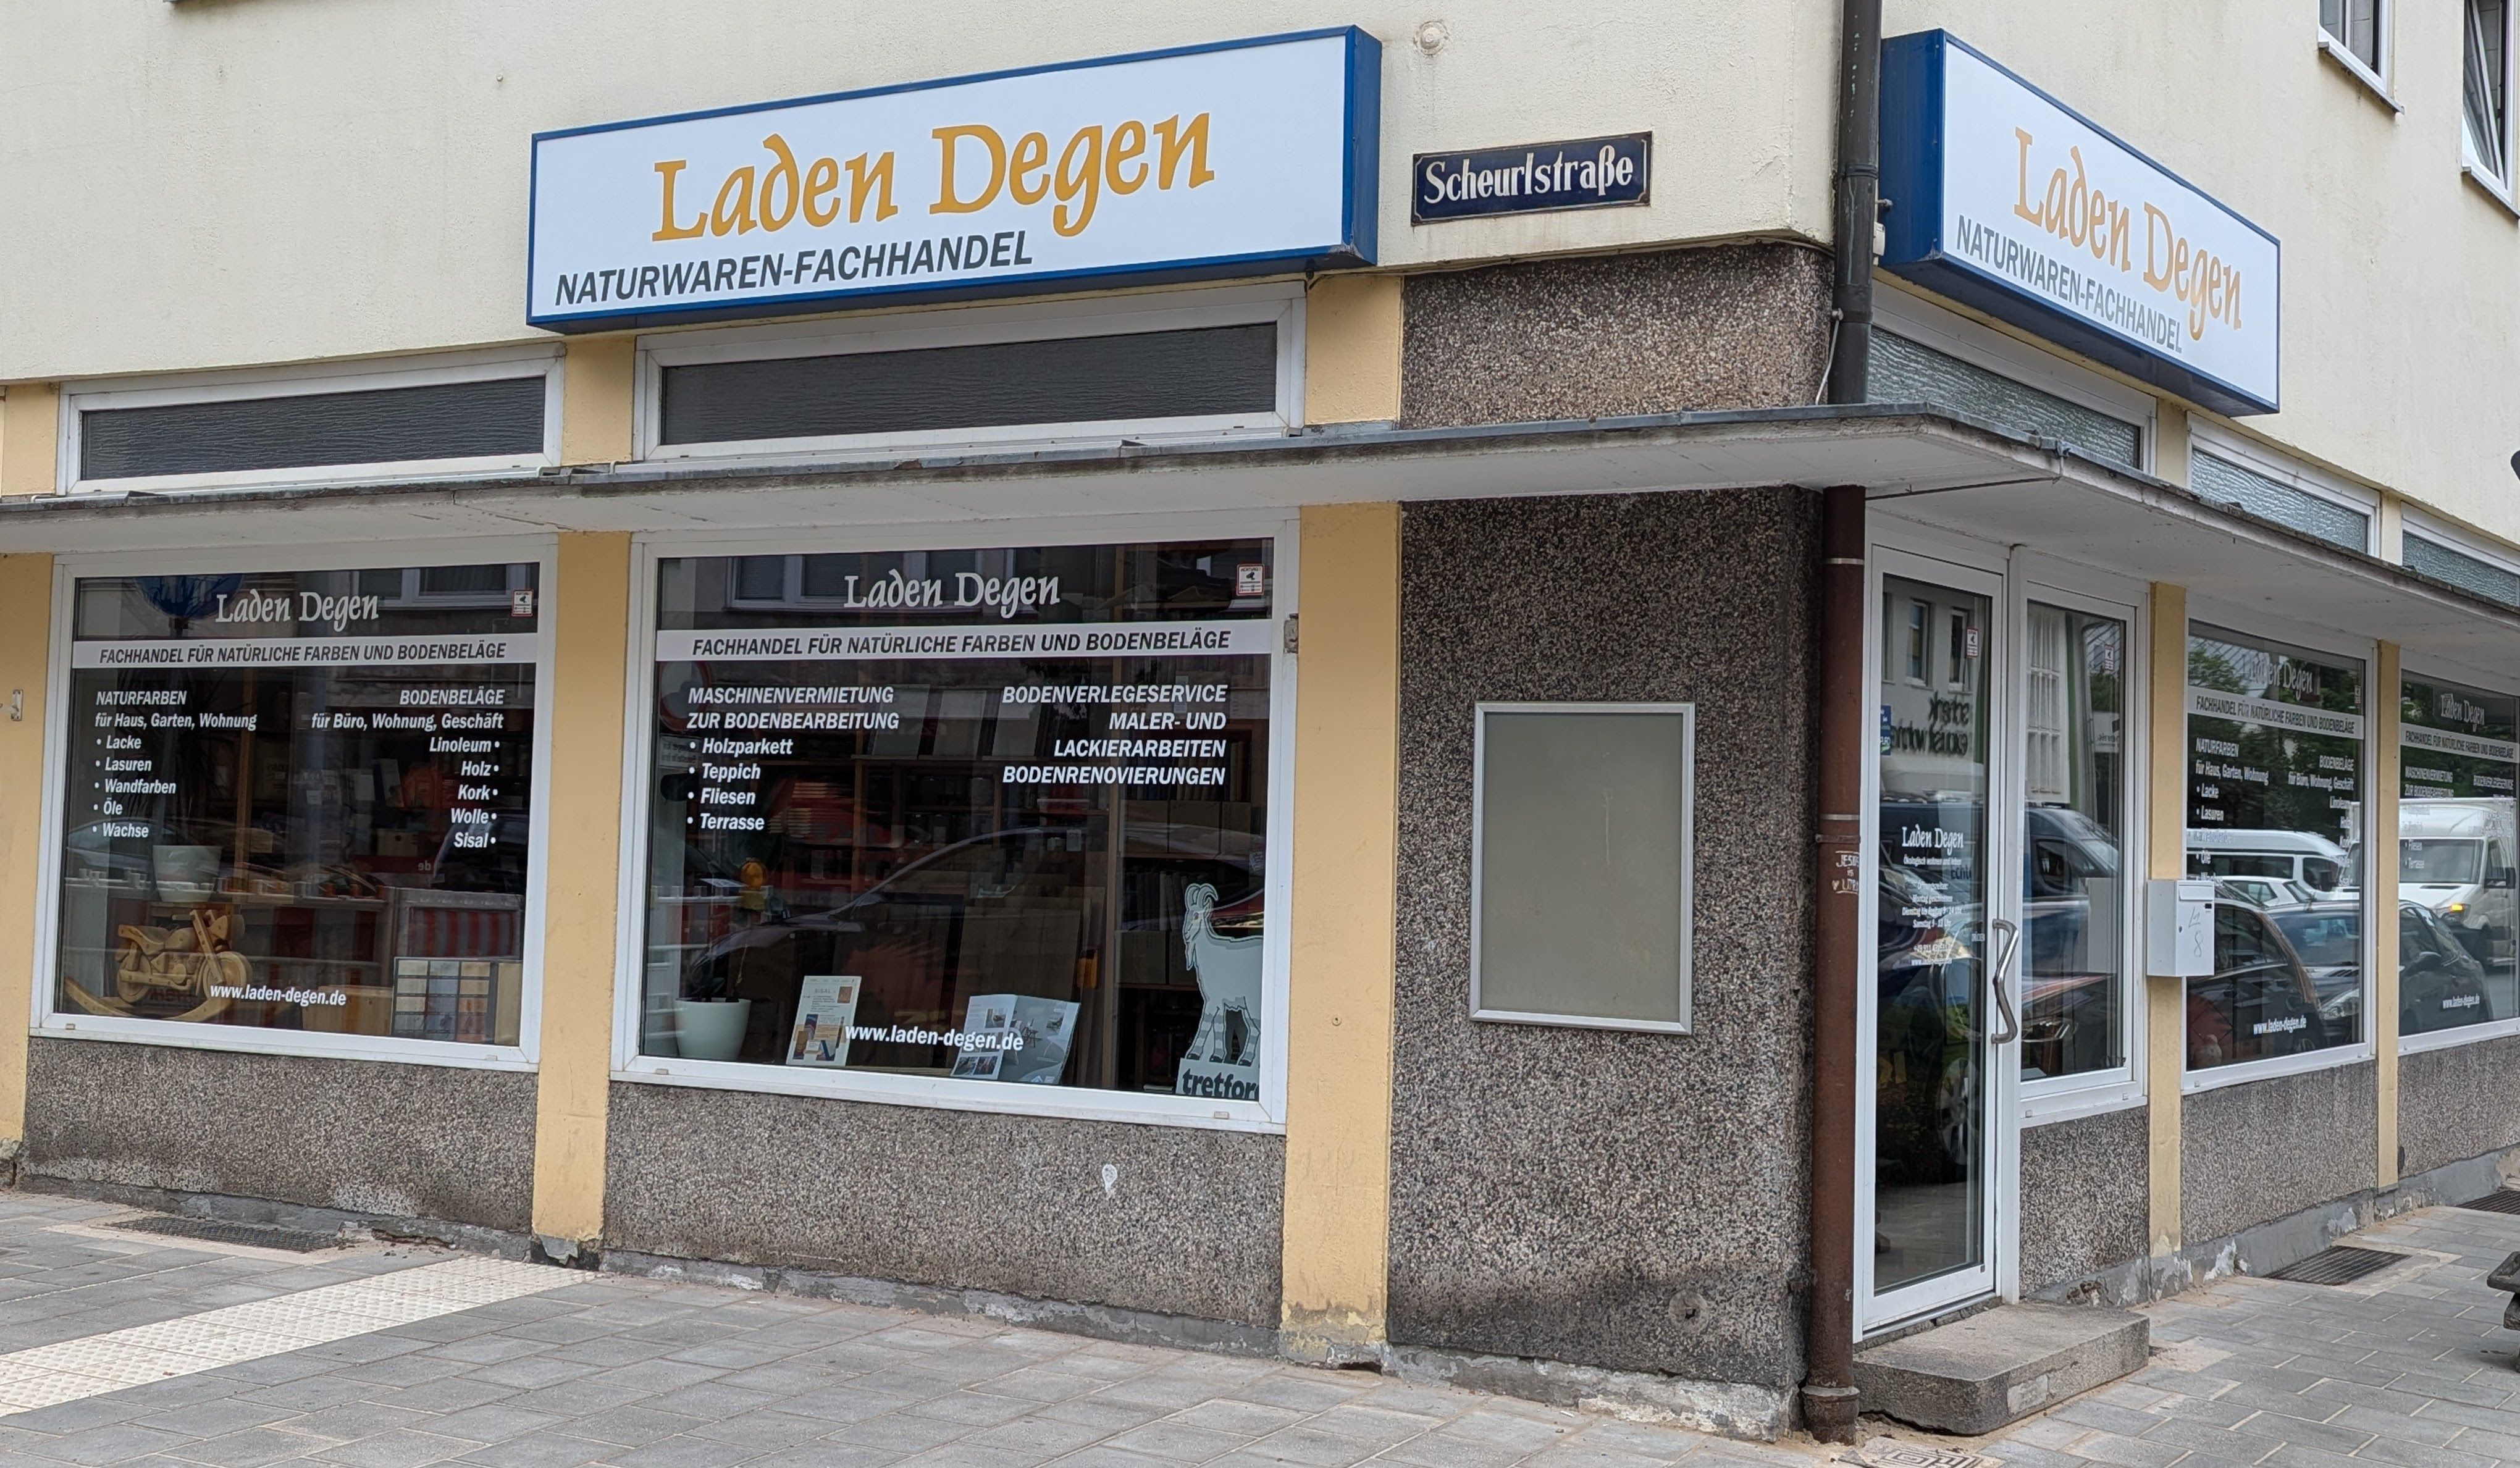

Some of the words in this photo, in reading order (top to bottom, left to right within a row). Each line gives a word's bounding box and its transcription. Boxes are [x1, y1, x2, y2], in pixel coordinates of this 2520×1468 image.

[652, 134, 897, 241] Laden
[929, 112, 1215, 237] Degen
[1424, 145, 1634, 204] Scheurlstraße
[2014, 126, 2131, 272] Laden
[2143, 201, 2241, 340] Degen
[554, 230, 1033, 306] NATURWAREN-FACHHANDEL
[1957, 214, 2182, 354] NATURWAREN-FACHHANDEL
[844, 568, 943, 608] Laden
[954, 572, 1060, 619] Degen
[216, 588, 291, 623] Laden
[299, 592, 379, 632] Degen
[692, 637, 803, 656] FACHHANDEL
[807, 633, 843, 655] FÜR
[847, 631, 957, 654] NATÜRLICHE
[961, 634, 1036, 653] FARBEN
[1041, 634, 1081, 652] UND
[1085, 626, 1232, 651] BODENBELÄGE
[99, 648, 184, 664] FACHHANDEL
[187, 644, 214, 663] FÜR
[217, 643, 301, 663] NATÜRLICHE
[303, 645, 361, 661] FARBEN
[363, 645, 394, 660] UND
[397, 639, 507, 660] BODENBELÄGE
[2249, 656, 2281, 687] Laden
[2282, 661, 2313, 702] Degen
[96, 690, 187, 705] NATURFARBEN
[400, 686, 505, 705] BODENBELÄGE
[687, 686, 894, 705] MASCHINENVERMIETUNG
[1001, 684, 1228, 703] BODENVERLEGESERVICE
[94, 712, 112, 728] für
[114, 713, 148, 729] Haus,
[151, 712, 195, 729] Garten,
[200, 713, 257, 731] Wohnung
[312, 712, 330, 728] für
[332, 713, 368, 731] Büro,
[372, 713, 437, 732] Wohnung,
[441, 712, 504, 729] Geschäft
[686, 712, 721, 729] ZUR
[725, 711, 900, 730] BODENBEARBEITUNG
[1109, 711, 1181, 731] MALER-
[1186, 711, 1227, 730] UND
[2196, 695, 2236, 716] FACHHANDEL
[2237, 700, 2249, 717] FÜR
[2250, 703, 2285, 724] NATÜRLICHE
[2285, 710, 2306, 728] FARBEN
[2307, 714, 2318, 728] UND
[2318, 717, 2355, 734] BODENBELÄGE
[2440, 693, 2463, 721] Laden
[2463, 699, 2485, 732] Degen
[106, 734, 142, 750] Lacke
[429, 736, 492, 753] Linoleum
[702, 737, 794, 758] Holzparkett
[1054, 739, 1226, 758] LACKIERARBEITEN
[2195, 737, 2240, 758] NATURFARBEN
[104, 757, 152, 772] Lasuren
[460, 760, 492, 777] Holz
[702, 763, 761, 783] Teppich
[2195, 759, 2204, 774] für
[2204, 761, 2221, 780] Haus,
[2222, 763, 2243, 782] Garten,
[2243, 766, 2269, 786] Wohnung
[2319, 755, 2354, 771] BODENBELÄGE
[1002, 765, 1226, 786] BODENRENOVIERUNGEN
[104, 778, 177, 794] Wandfarben
[457, 784, 490, 800] Kork
[700, 787, 756, 805] Fliesen
[2201, 782, 2219, 799] Lacke
[103, 797, 124, 816] Öle
[450, 807, 489, 825] Wolle
[2201, 805, 2224, 821] Lasuren
[102, 821, 149, 839] Wachse
[700, 812, 765, 831] Terrasse
[453, 831, 487, 849] Sisal
[1902, 823, 1932, 848] Laden
[1934, 828, 1964, 857] Degen
[210, 983, 346, 1007] www.laden-degen.de
[2253, 1014, 2308, 1036] www.laden-degen.de
[845, 1024, 1023, 1052] www.laden-degen.de
